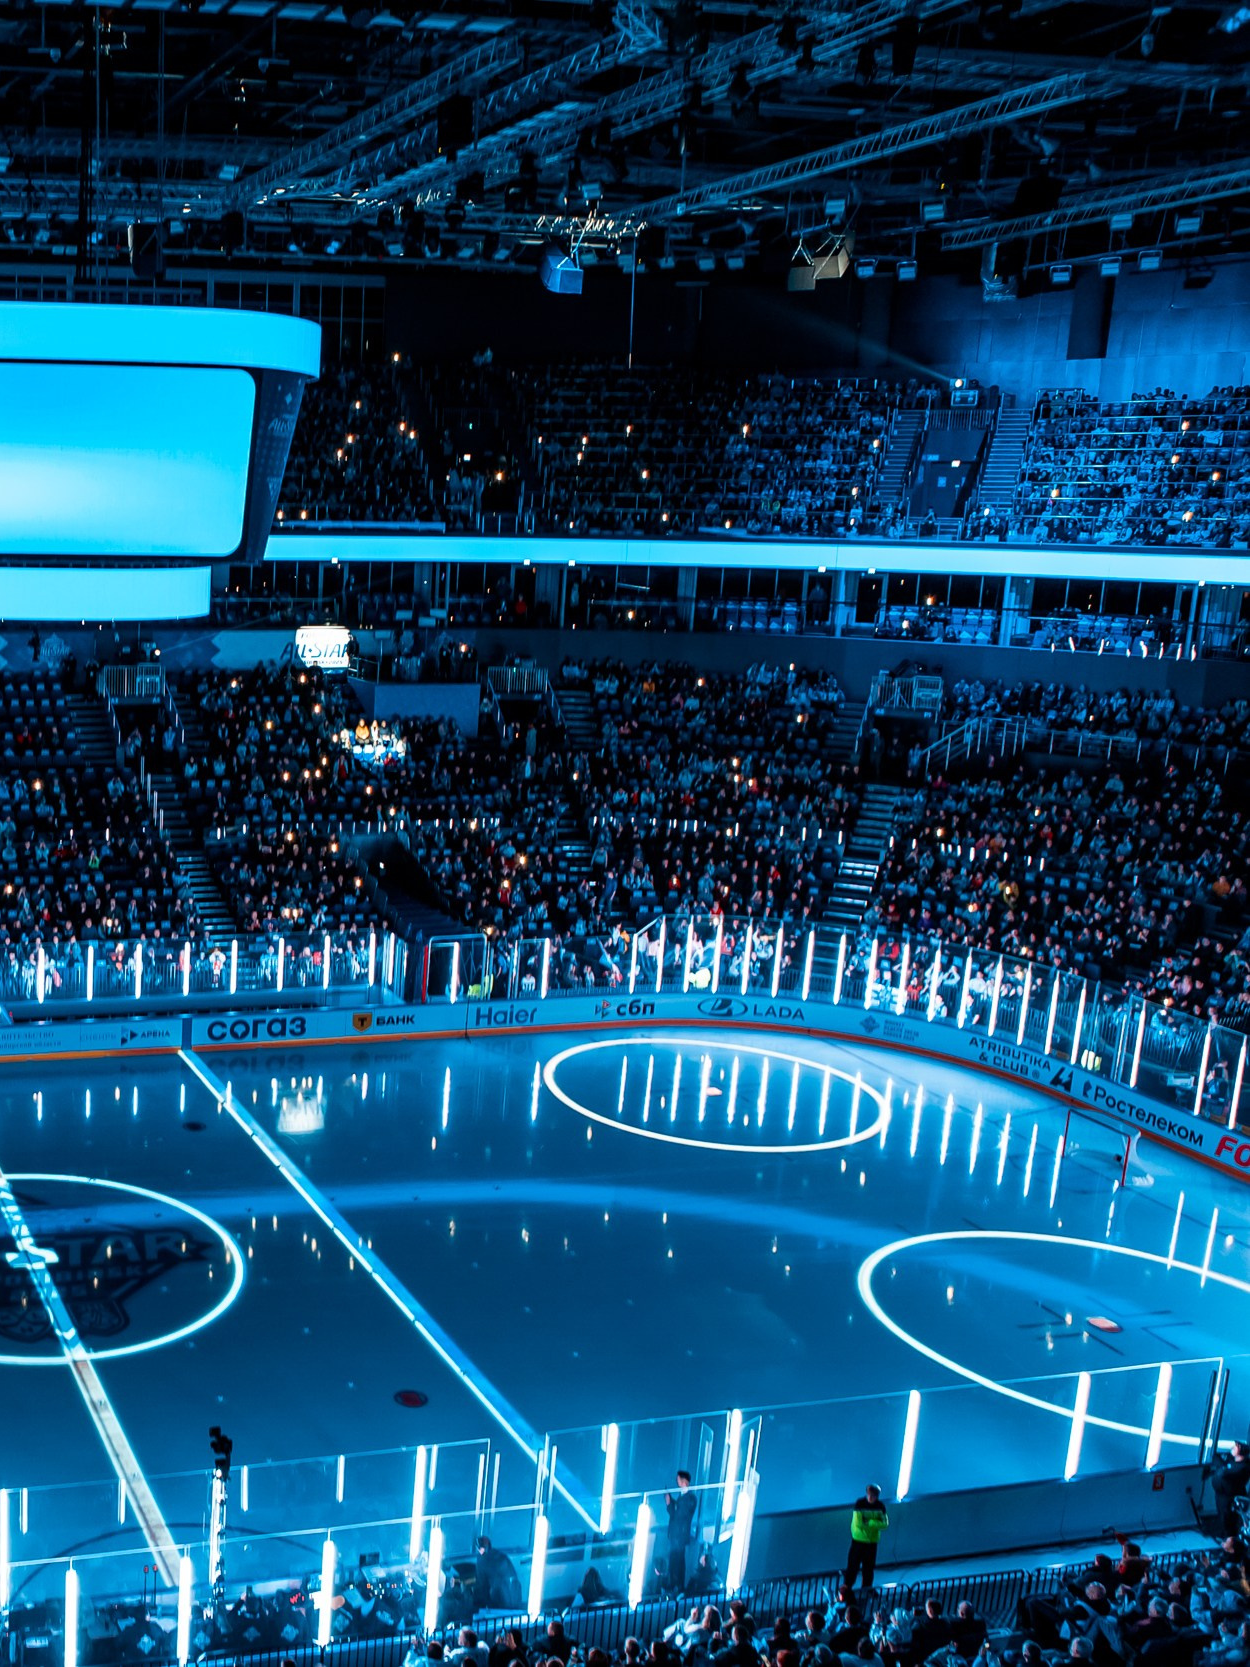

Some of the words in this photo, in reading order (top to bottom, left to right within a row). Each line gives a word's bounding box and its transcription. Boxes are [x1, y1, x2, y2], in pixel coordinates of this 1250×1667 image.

[376, 1013, 415, 1026] БАНК
[475, 1004, 537, 1026] Haier
[753, 1003, 805, 1020] LADA
[969, 1037, 1051, 1072] ATRIBUTIKA
[979, 1052, 989, 1062] &
[993, 1056, 1029, 1075] CLUB
[1093, 1086, 1204, 1147] Ростелеком
